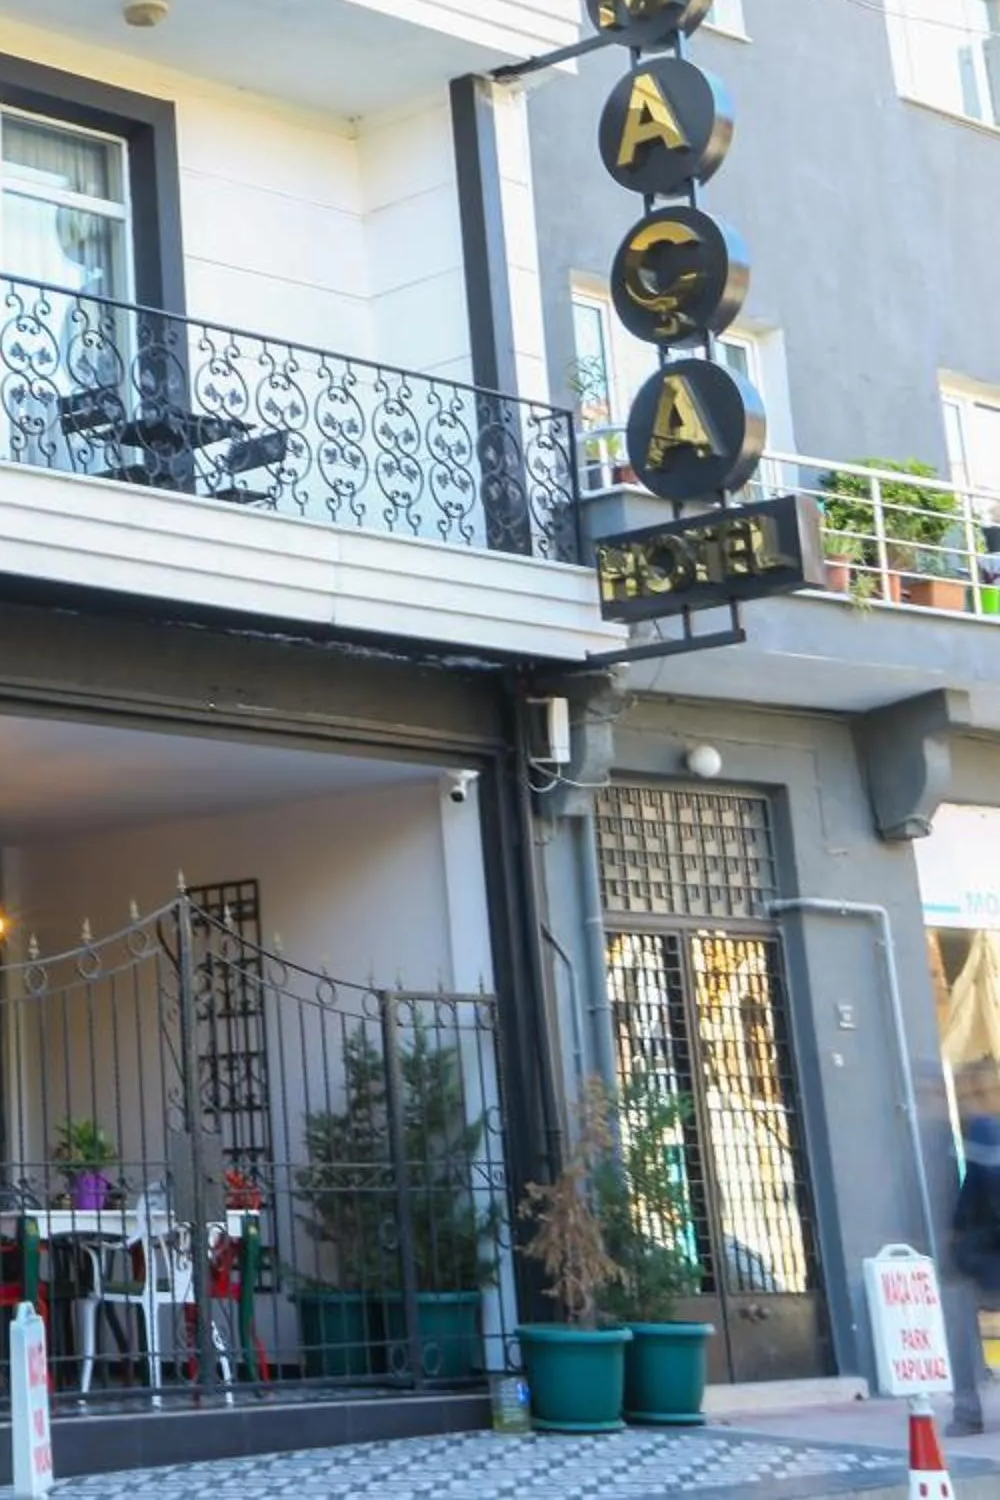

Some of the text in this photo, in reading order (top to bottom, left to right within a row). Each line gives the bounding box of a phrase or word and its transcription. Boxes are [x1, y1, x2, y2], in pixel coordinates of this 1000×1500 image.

[597, 514, 795, 601] HOTEL
[900, 1328, 931, 1351] PARK
[892, 1357, 948, 1381] YAPILMAZ
